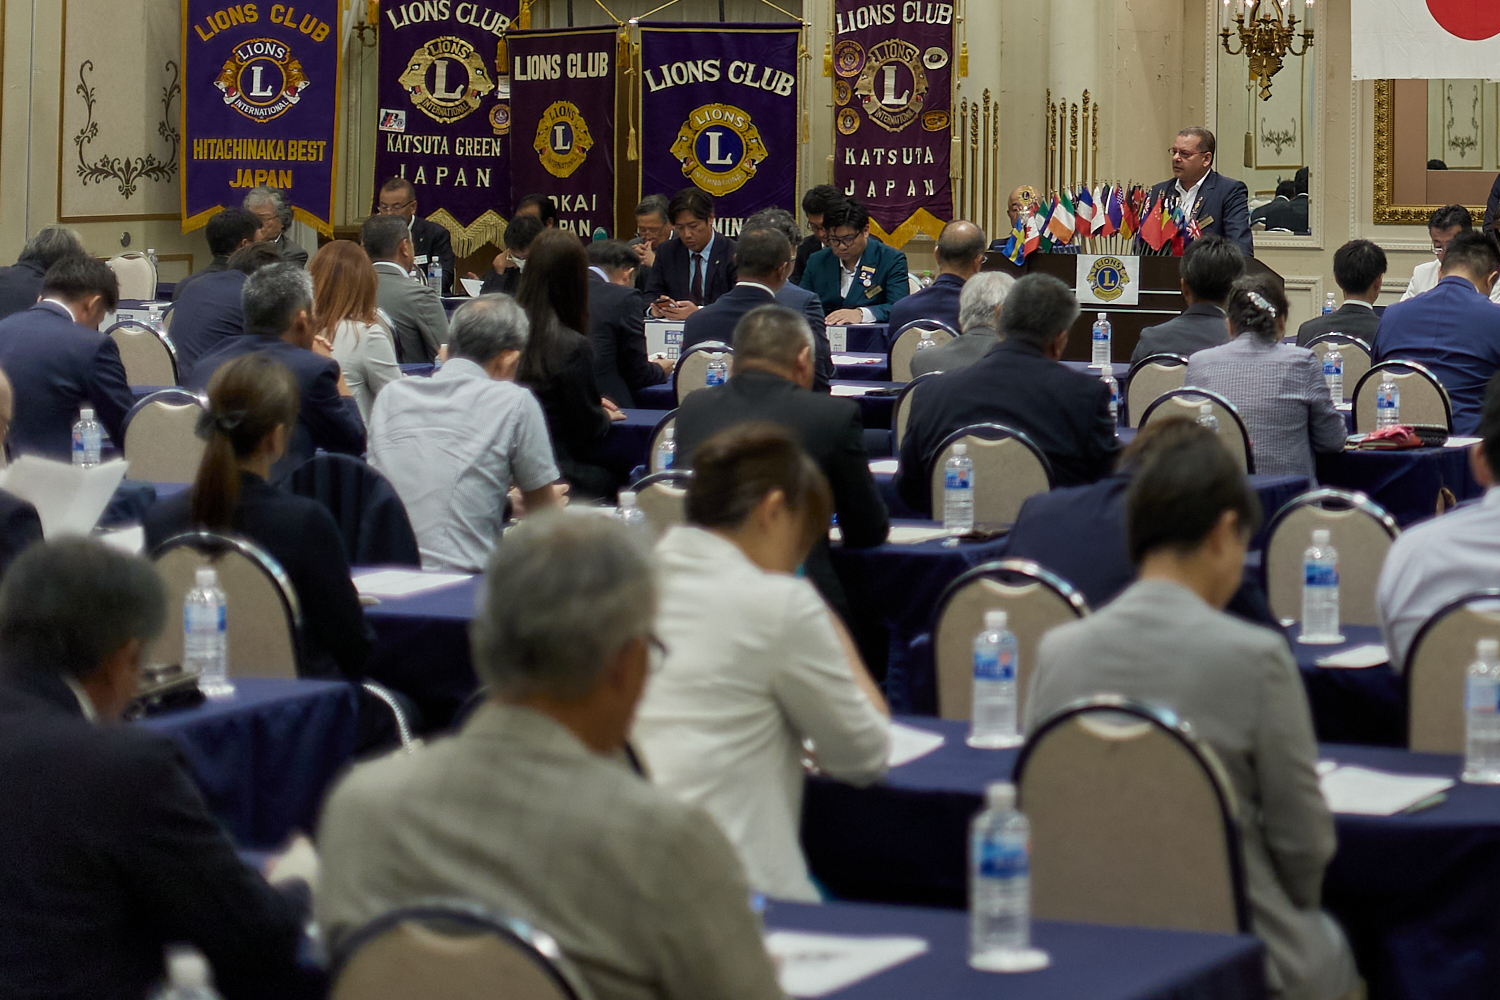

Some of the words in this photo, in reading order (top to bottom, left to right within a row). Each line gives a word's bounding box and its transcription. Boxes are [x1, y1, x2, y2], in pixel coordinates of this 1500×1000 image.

[194, 3, 258, 42] LIONS
[269, 4, 330, 42] CLUB
[385, 0, 451, 30] LIONS
[455, 2, 511, 37] CLUB
[836, 3, 896, 34] LIONS
[902, 1, 953, 25] CLUB
[237, 42, 285, 60] LIONS
[429, 41, 470, 59] LIONS
[874, 43, 915, 61] LIONS
[514, 54, 561, 81] LIONS
[566, 52, 609, 78] CLUB
[250, 66, 272, 96] L
[433, 60, 464, 100] L
[643, 59, 721, 92] LIONS
[727, 60, 795, 97] CLUB
[881, 65, 910, 105] L
[234, 99, 289, 116] INTERNATIONAL
[421, 100, 470, 116] INTERNATIONAL
[549, 105, 576, 120] LIONS
[695, 108, 745, 128] LIONS
[387, 133, 449, 155] KATSUTA
[455, 137, 501, 156] GREEN
[553, 125, 571, 150] L
[193, 138, 285, 160] HITACHINAKA
[287, 140, 326, 162] BEST
[705, 132, 733, 165] L
[845, 147, 934, 165] KATSUTA
[229, 169, 292, 188] JAPAN
[845, 179, 934, 197] JAPAN
[559, 219, 591, 237] PAN
[1096, 258, 1121, 268] LIONS
[1103, 270, 1115, 286] L
